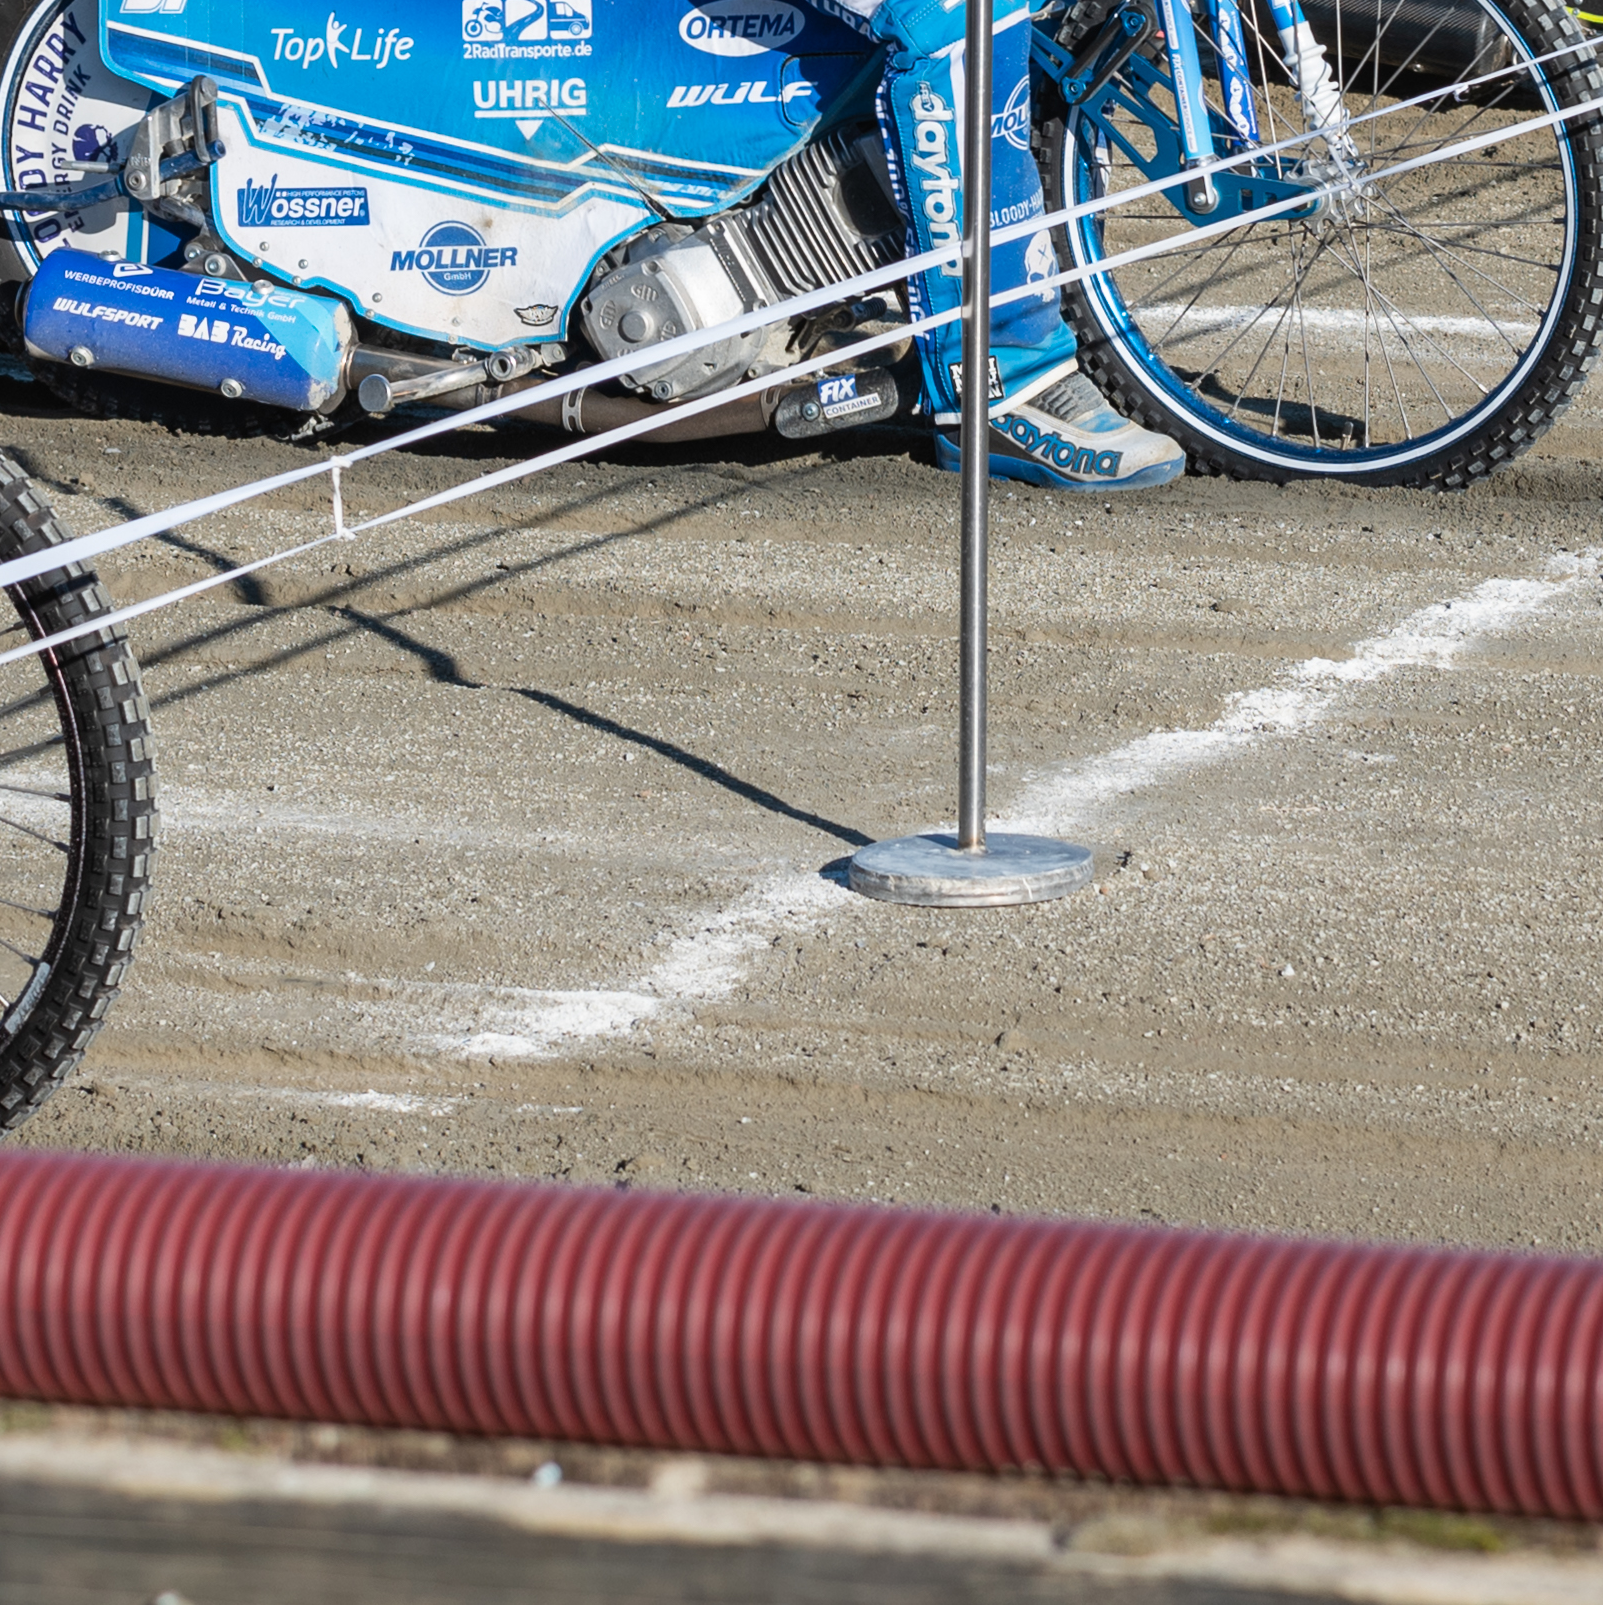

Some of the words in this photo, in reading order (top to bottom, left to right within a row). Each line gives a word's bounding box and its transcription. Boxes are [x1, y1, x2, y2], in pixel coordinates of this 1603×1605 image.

[684, 10, 796, 40] ORTEMA
[270, 27, 325, 70] Top
[350, 27, 415, 70] Life
[463, 42, 593, 60] 2RadTransporte.de
[1171, 52, 1186, 72] FIX
[16, 11, 87, 132] HARRY
[54, 64, 92, 137] DRINK
[472, 77, 588, 109] UHRIG
[665, 80, 819, 108] WULF
[389, 246, 519, 273] MOLLNER
[442, 270, 472, 282] GmbH
[194, 277, 306, 310] Bayer
[52, 297, 165, 332] WULFSPORT
[230, 303, 265, 318] Technik
[266, 312, 297, 324] GmbH
[230, 325, 287, 360] Racing
[820, 377, 857, 403] FIX
[823, 393, 882, 419] CONTAINER
